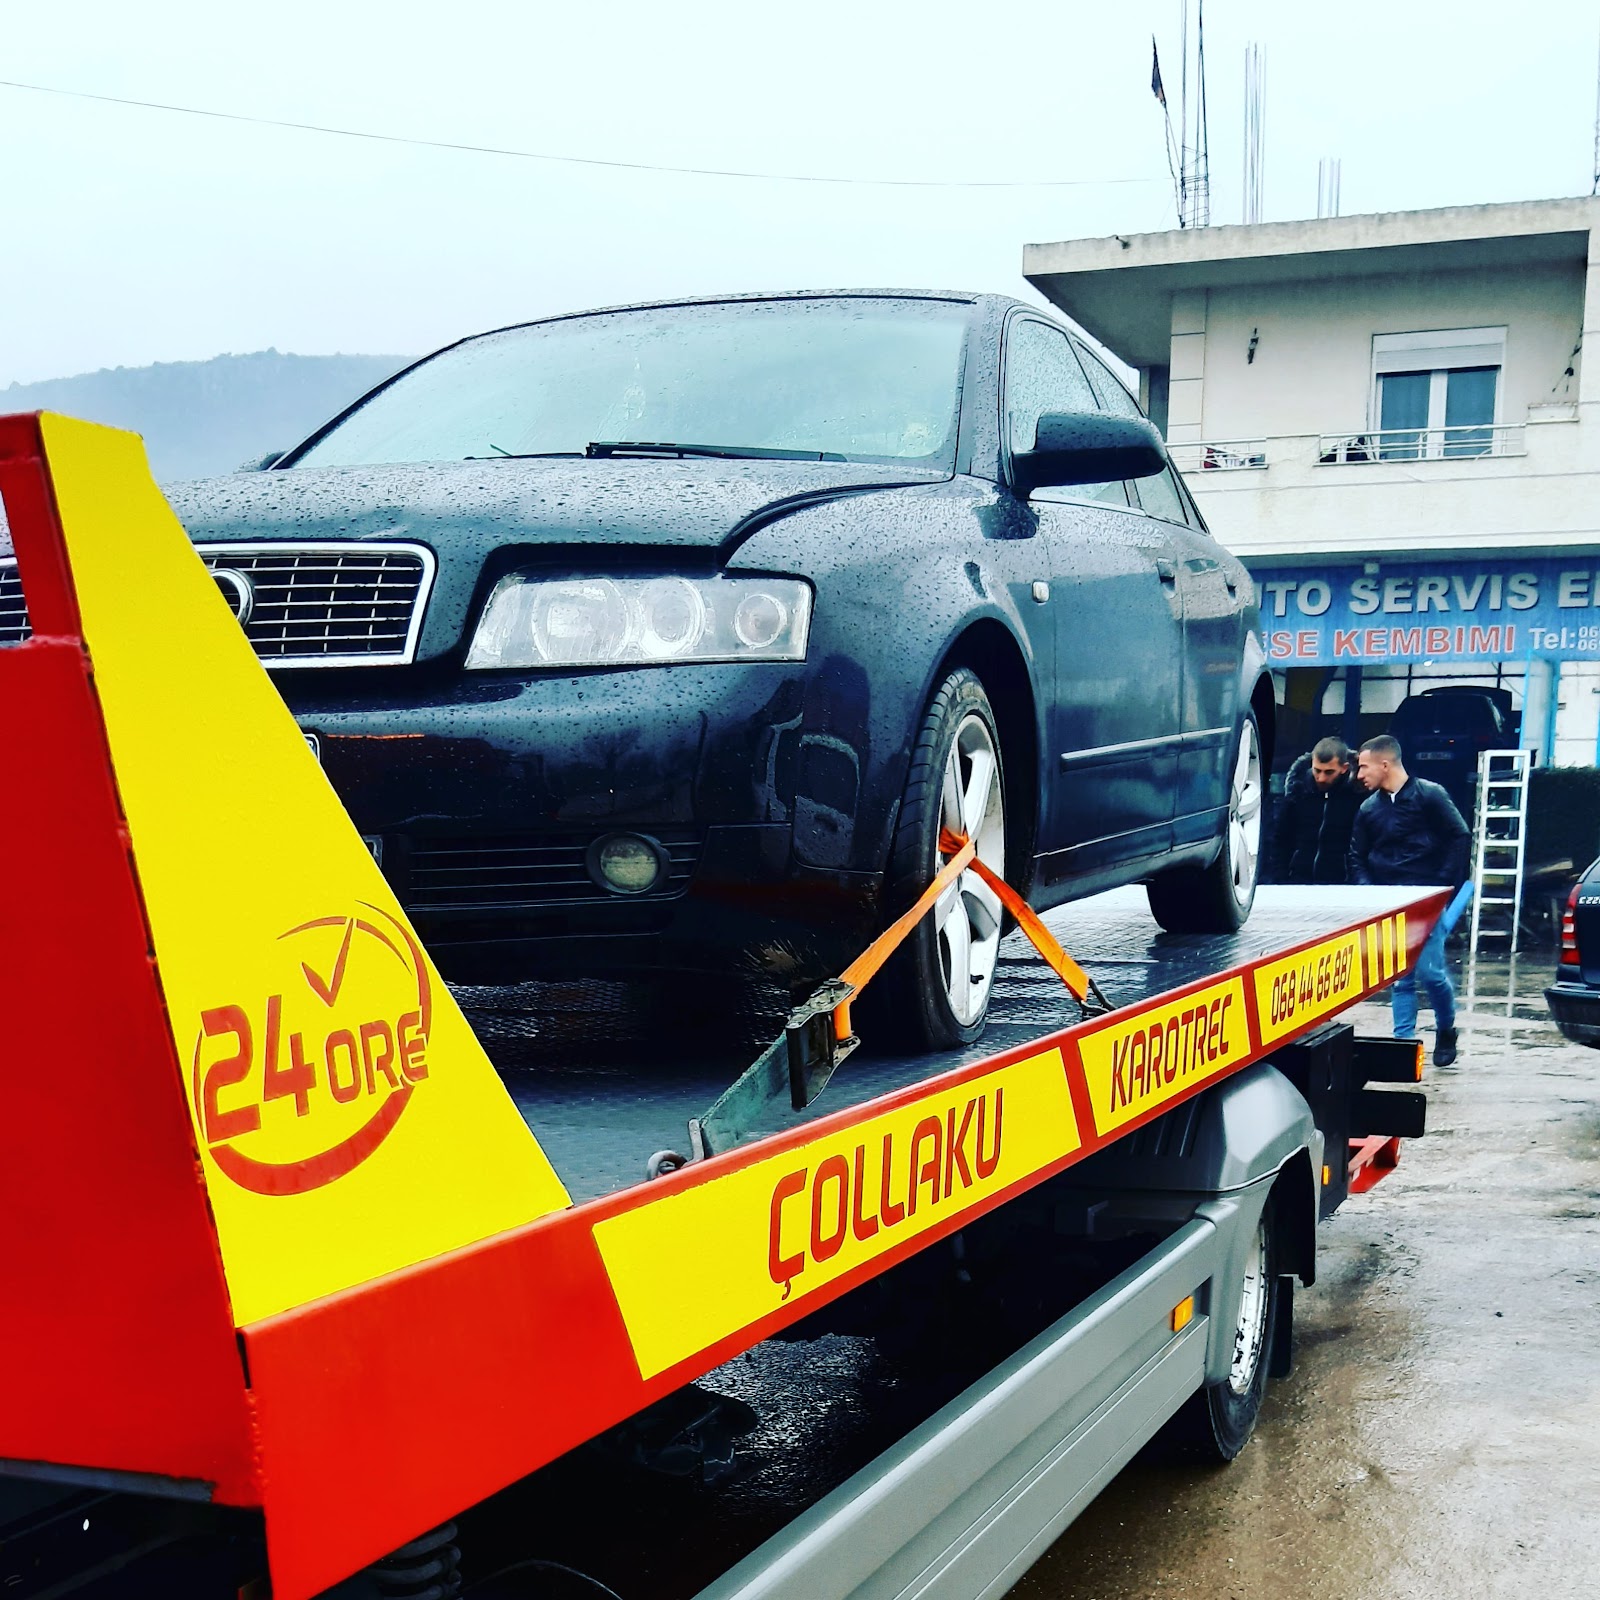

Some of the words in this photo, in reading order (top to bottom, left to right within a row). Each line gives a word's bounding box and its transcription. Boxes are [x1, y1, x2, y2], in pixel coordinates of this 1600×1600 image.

[1349, 572, 1540, 616] SERVIS
[1557, 571, 1600, 608] E
[1261, 629, 1320, 659] SE
[1333, 625, 1517, 658] KEMBIMI
[1528, 626, 1576, 650] Tel:
[1578, 625, 1600, 639] 06
[1577, 638, 1600, 651] 06
[1578, 896, 1600, 905] C22
[1271, 969, 1297, 1026] 068
[1298, 961, 1314, 1012] 44
[1316, 953, 1332, 1003] 66
[1333, 944, 1354, 994] 887
[200, 994, 317, 1144] 24
[325, 1010, 430, 1104] ORE
[768, 1087, 1004, 1301] ÇOLLAKU
[1110, 992, 1233, 1114] KAROTREC
